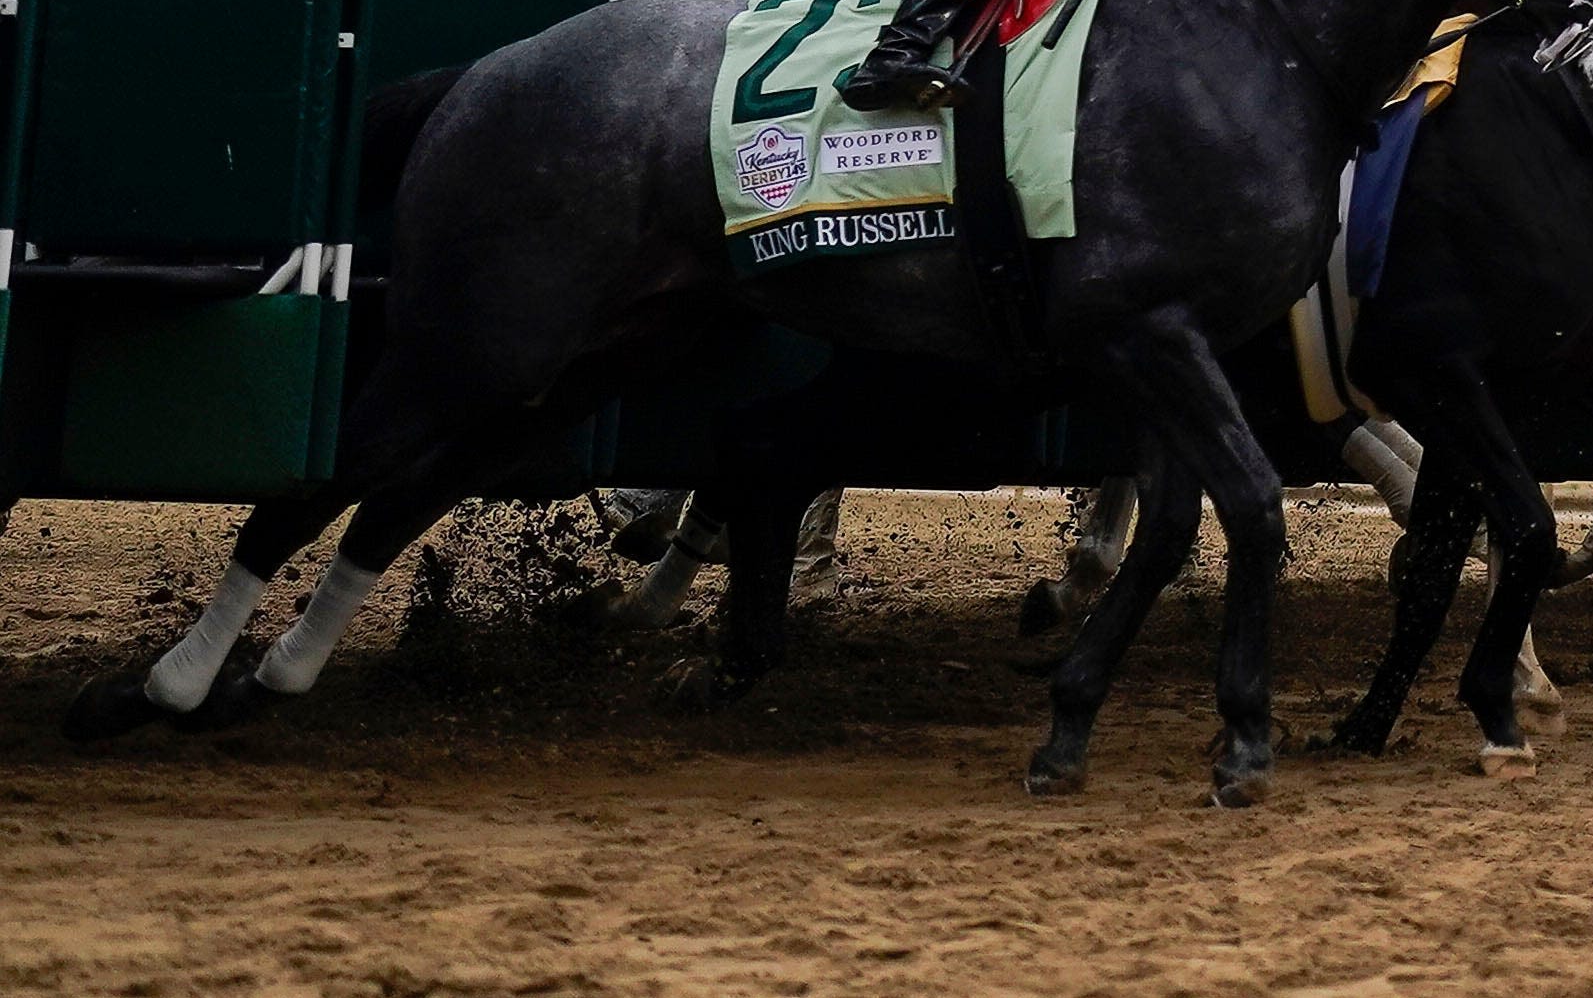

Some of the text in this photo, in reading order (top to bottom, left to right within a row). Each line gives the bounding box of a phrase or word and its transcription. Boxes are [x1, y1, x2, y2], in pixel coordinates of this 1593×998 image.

[823, 128, 938, 150] WOODFORD
[836, 150, 930, 169] RESERVE
[750, 208, 955, 263] KING RUSSELL
